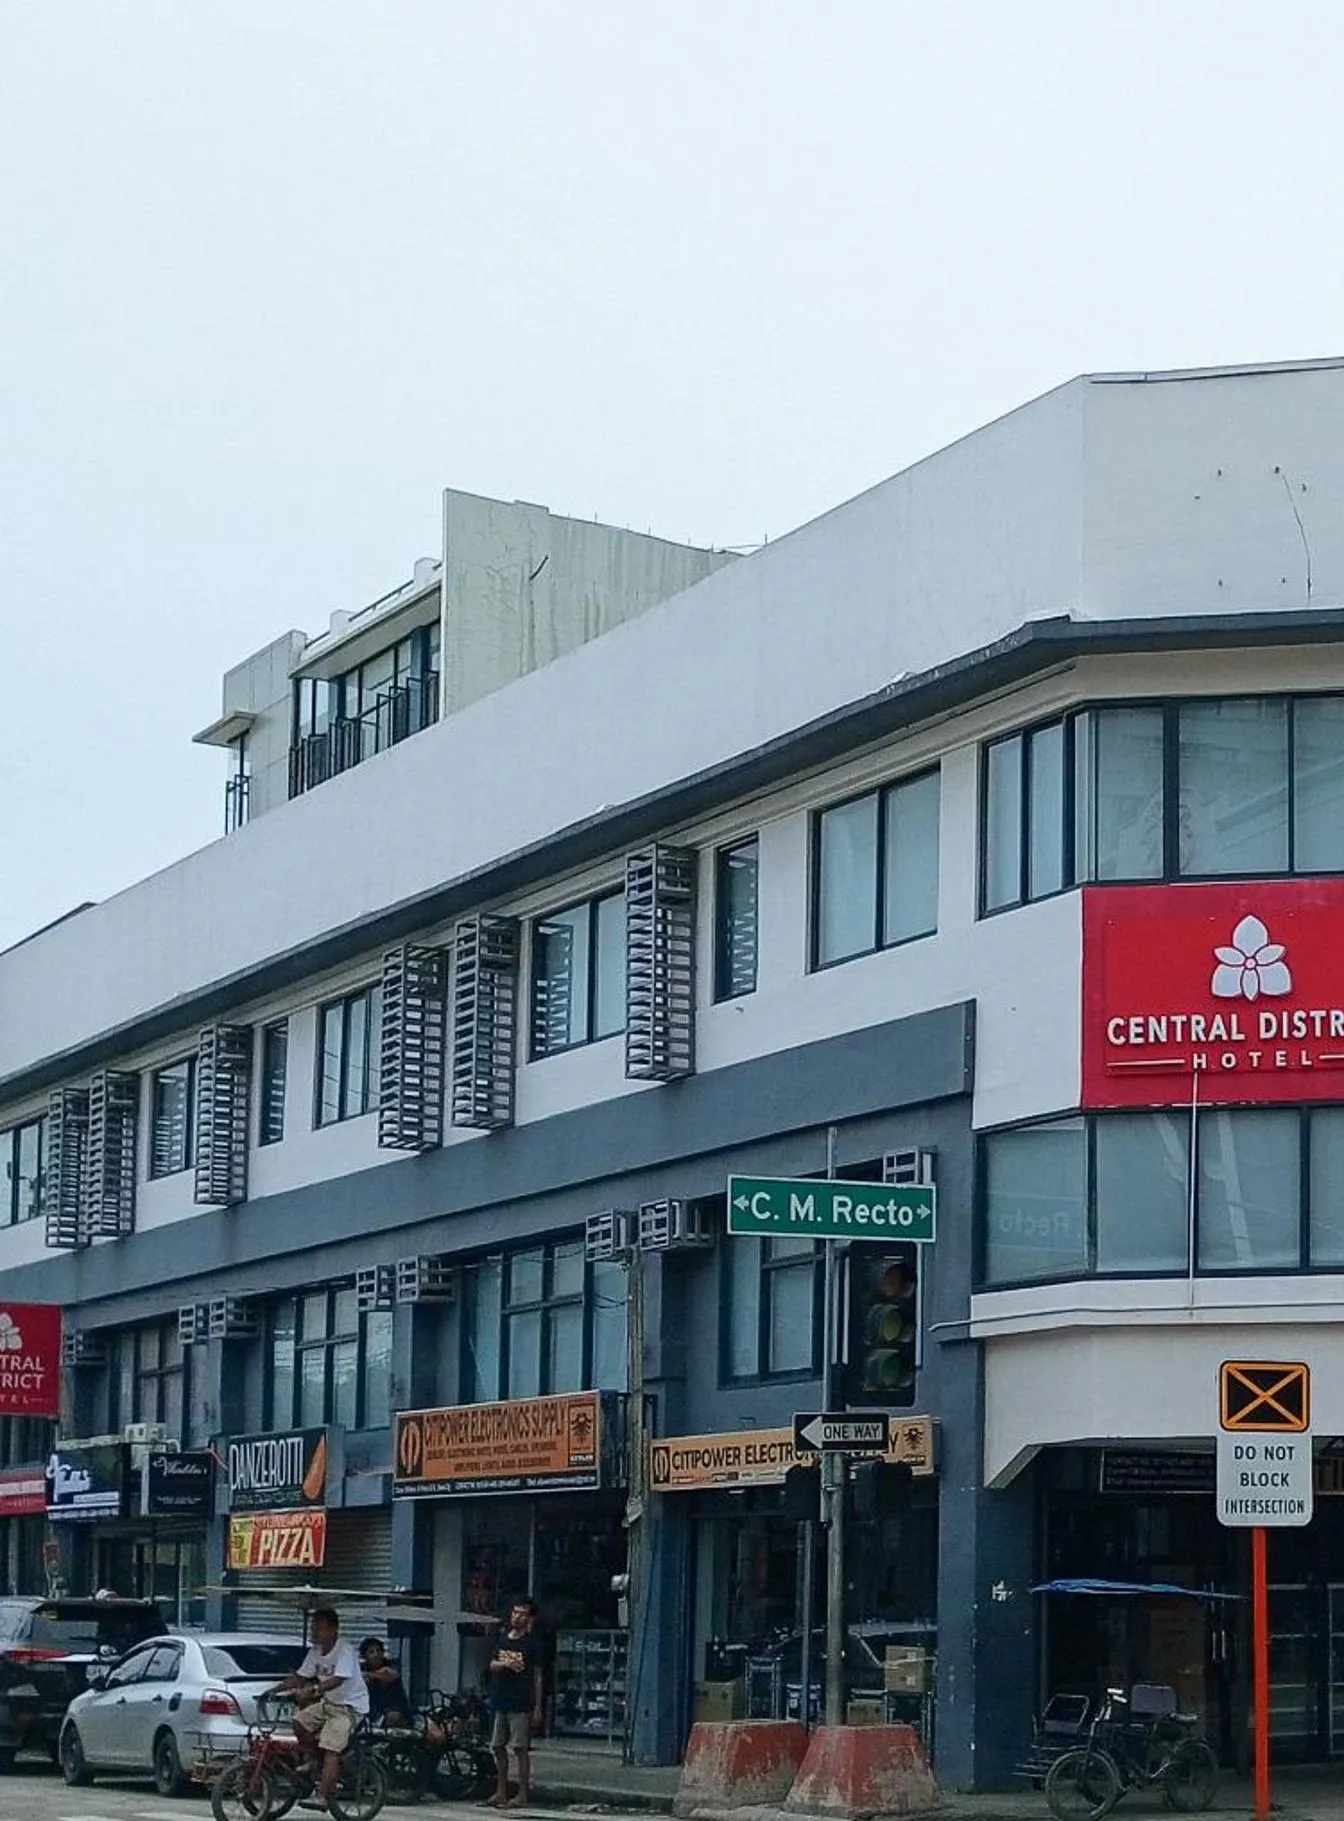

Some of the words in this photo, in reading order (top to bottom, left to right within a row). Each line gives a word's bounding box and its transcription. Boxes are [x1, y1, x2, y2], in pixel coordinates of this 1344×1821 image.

[1106, 1013, 1246, 1045] CENTRAL
[1193, 1050, 1313, 1070] HOTEL
[751, 1191, 780, 1221] C.
[789, 1193, 823, 1222] M.
[832, 1195, 914, 1226] Recto
[0, 1354, 45, 1372] TRAL
[0, 1373, 45, 1389] RICT
[824, 1425, 849, 1440] ONE
[854, 1424, 881, 1439] WAY
[672, 1446, 741, 1471] CITIPOWER
[1233, 1445, 1257, 1461] DO
[1264, 1445, 1296, 1461] NOT
[1239, 1472, 1291, 1488] BLOCK
[1224, 1499, 1306, 1515] INTERSECTION
[258, 1527, 315, 1567] PIZZA
